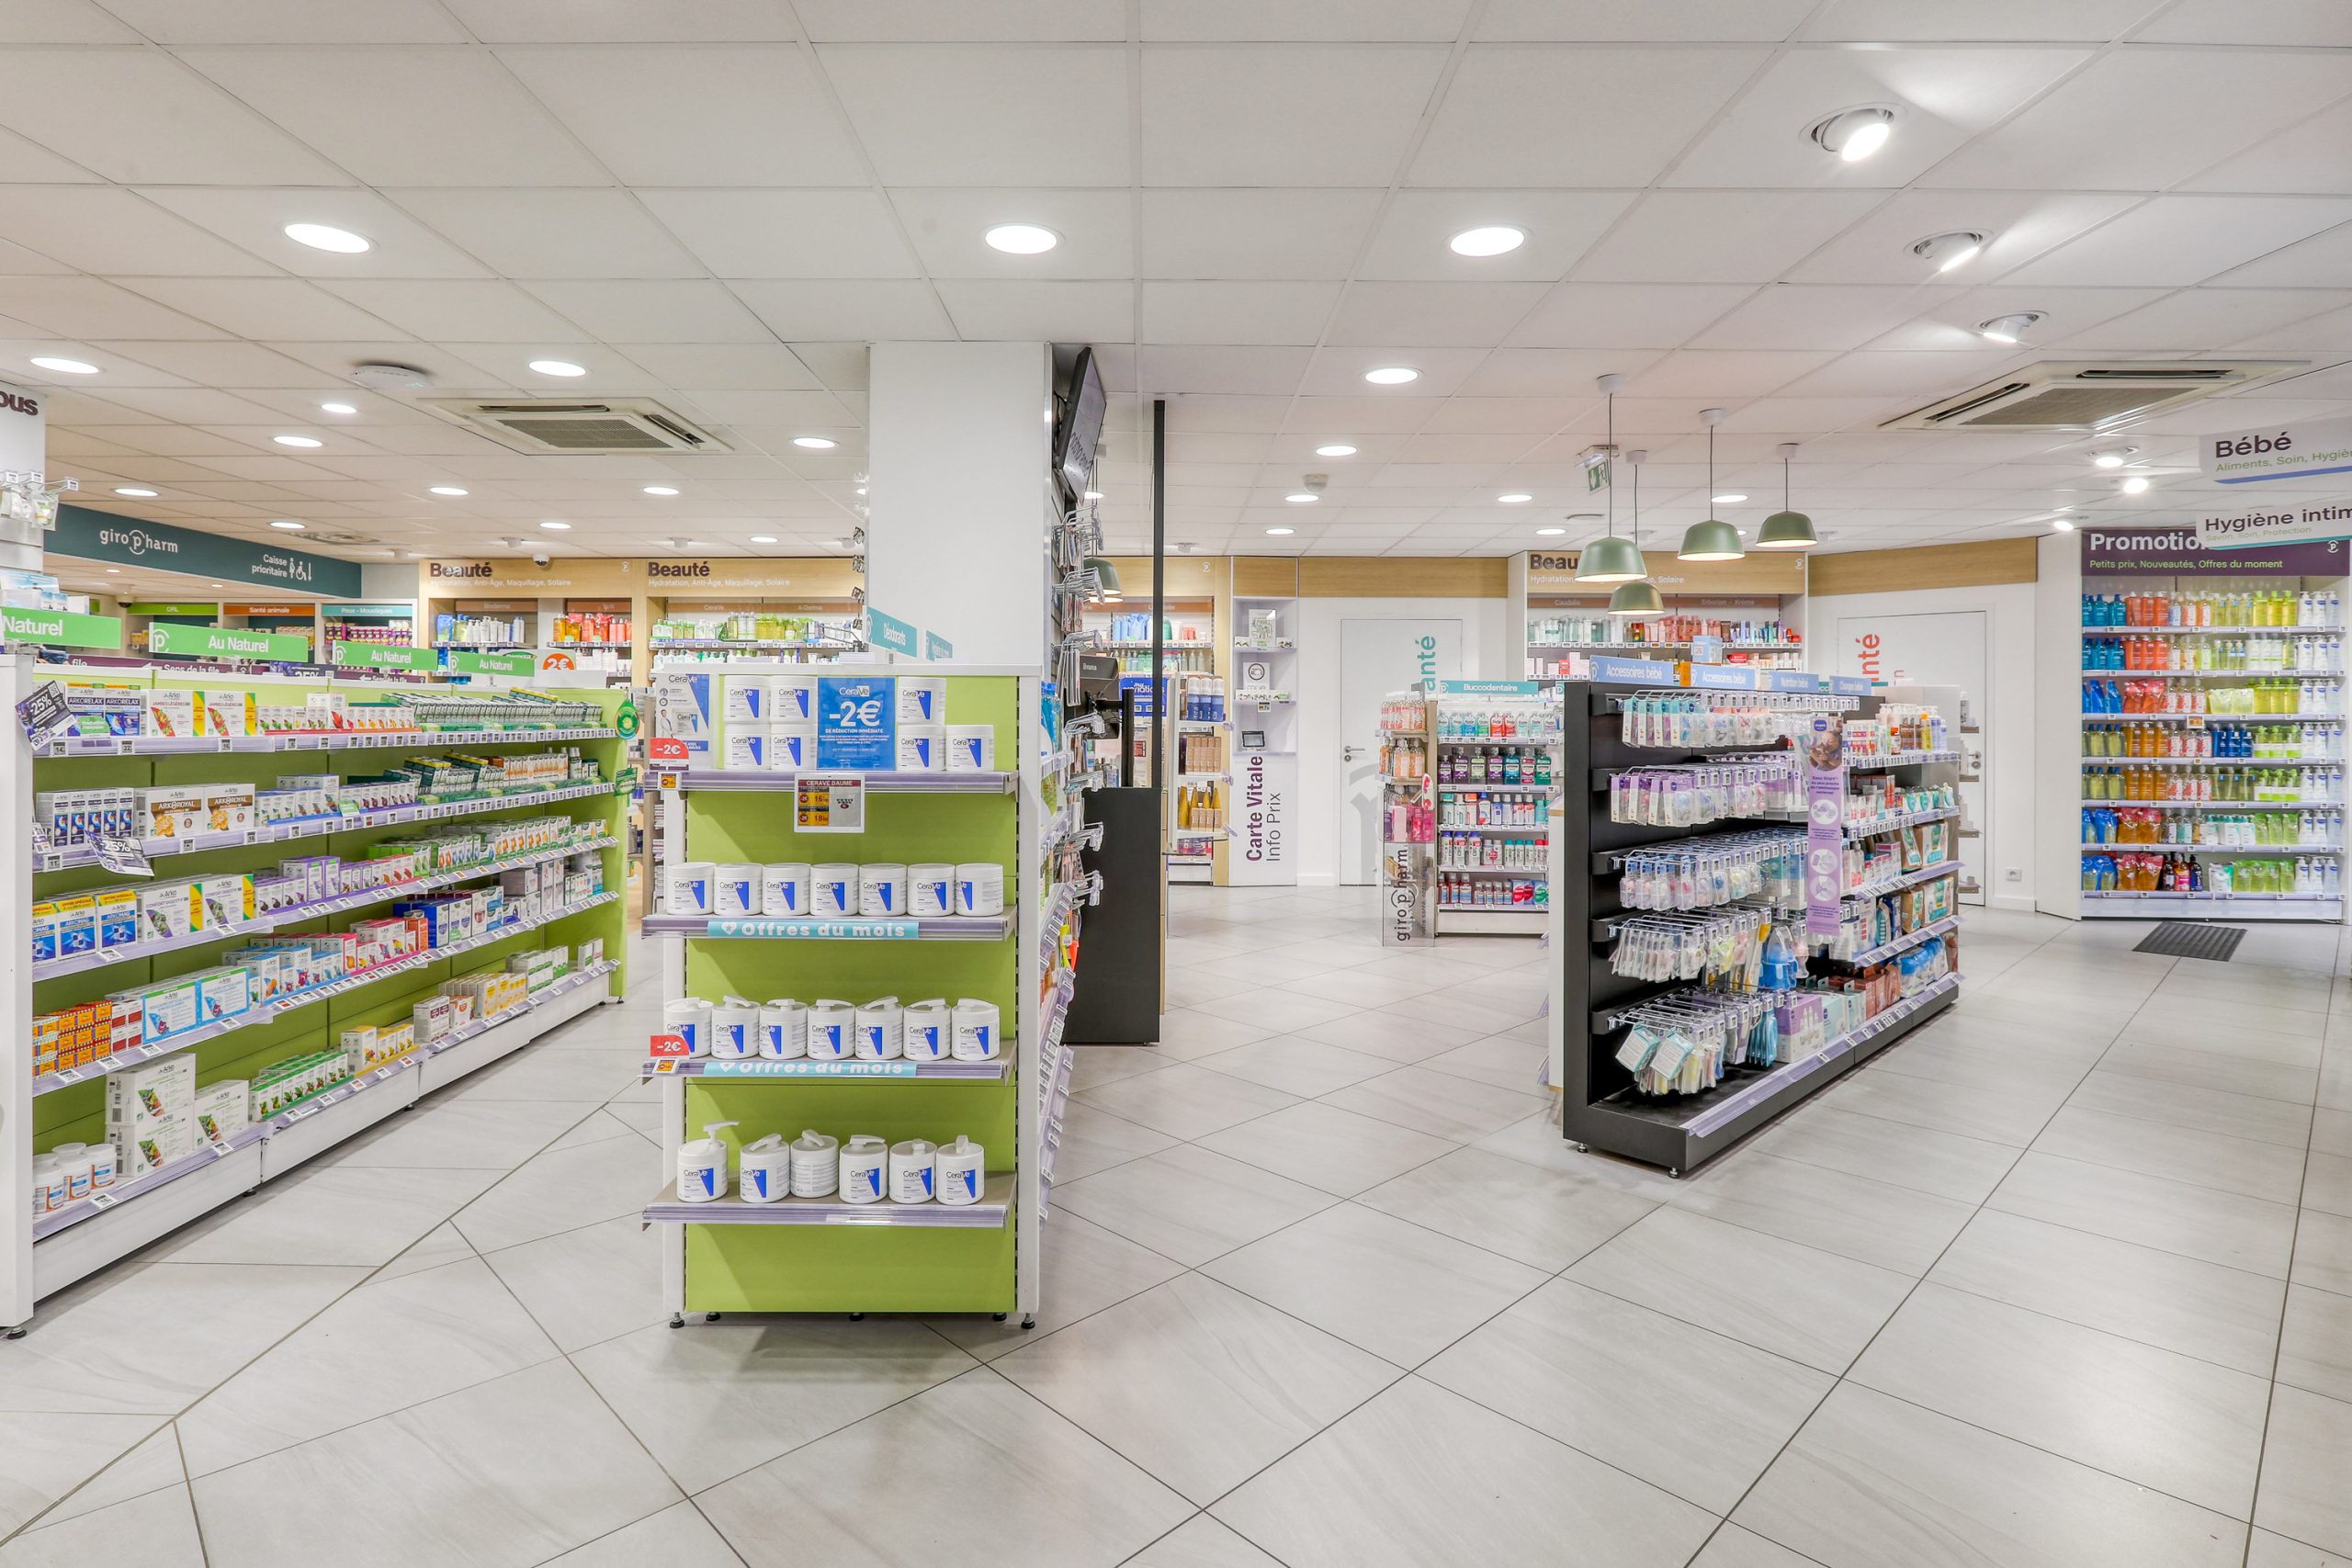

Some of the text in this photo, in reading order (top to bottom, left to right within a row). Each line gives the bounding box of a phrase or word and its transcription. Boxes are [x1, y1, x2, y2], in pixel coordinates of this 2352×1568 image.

[2215, 432, 2292, 458] Bébé
[2312, 449, 2352, 462] Hygiè
[2205, 513, 2294, 533] Hygiène
[2263, 526, 2312, 536] Protection
[2090, 532, 2205, 551] Promotio
[263, 554, 288, 567] Caisse
[1530, 554, 1578, 570] Beau
[2089, 559, 2283, 570] Petits prix, Nouveautés, Offres du moment
[252, 564, 288, 578] prioritaire
[430, 562, 492, 577] Beauté
[648, 560, 710, 577] Beauté
[765, 579, 791, 587] Solaire
[1657, 576, 1685, 584] Solaire
[4, 616, 62, 637] Naturel
[208, 635, 269, 652] Au Naturel
[370, 650, 412, 663] Au Naturel
[479, 660, 514, 671] Au Naturel
[1606, 663, 1663, 680] Accessoires bébé
[668, 674, 697, 683] CeraVe
[1702, 671, 1747, 684] Accessoires bébé
[839, 685, 870, 696] CeraVe
[1464, 683, 1518, 692] Buccodentaire
[729, 689, 753, 697] CeraVe
[778, 689, 803, 697] CeraVe
[902, 689, 925, 698] CeraVe
[29, 694, 52, 716] -25%
[830, 700, 883, 727] -2€
[731, 737, 756, 745] CeraVe
[774, 737, 795, 745] CeraVe
[900, 738, 923, 746] CeraVe
[952, 739, 976, 747] CeraVe
[656, 744, 682, 755] -2€
[158, 801, 195, 809] ARKOROYAL
[214, 796, 247, 805] ARKOROYAL
[1246, 756, 1263, 862] Carte Vitale
[1266, 793, 1281, 862] Info Prix
[100, 840, 130, 852] -25%
[674, 880, 698, 889] CeraVe
[719, 881, 742, 890] CeraVe
[766, 881, 789, 890] CeraVe
[816, 882, 839, 890] CeraVe
[864, 882, 886, 890] CeraVe
[917, 882, 941, 890] CeraVe
[106, 910, 132, 919] ARKOMAG
[65, 919, 91, 927] ARKOMAG
[741, 921, 905, 937] Offres du mois
[667, 1023, 689, 1032] CeraVe
[715, 1024, 738, 1032] CeraVe
[811, 1025, 834, 1033] CeraVe
[910, 1026, 932, 1035] CeraVe
[959, 1026, 983, 1035] CeraVe
[656, 1040, 682, 1052] -2€
[739, 1062, 903, 1074] Offres du mois
[850, 1169, 875, 1178] CeraVe
[903, 1169, 927, 1178] CeraVe
[946, 1169, 970, 1179] CeraVe
